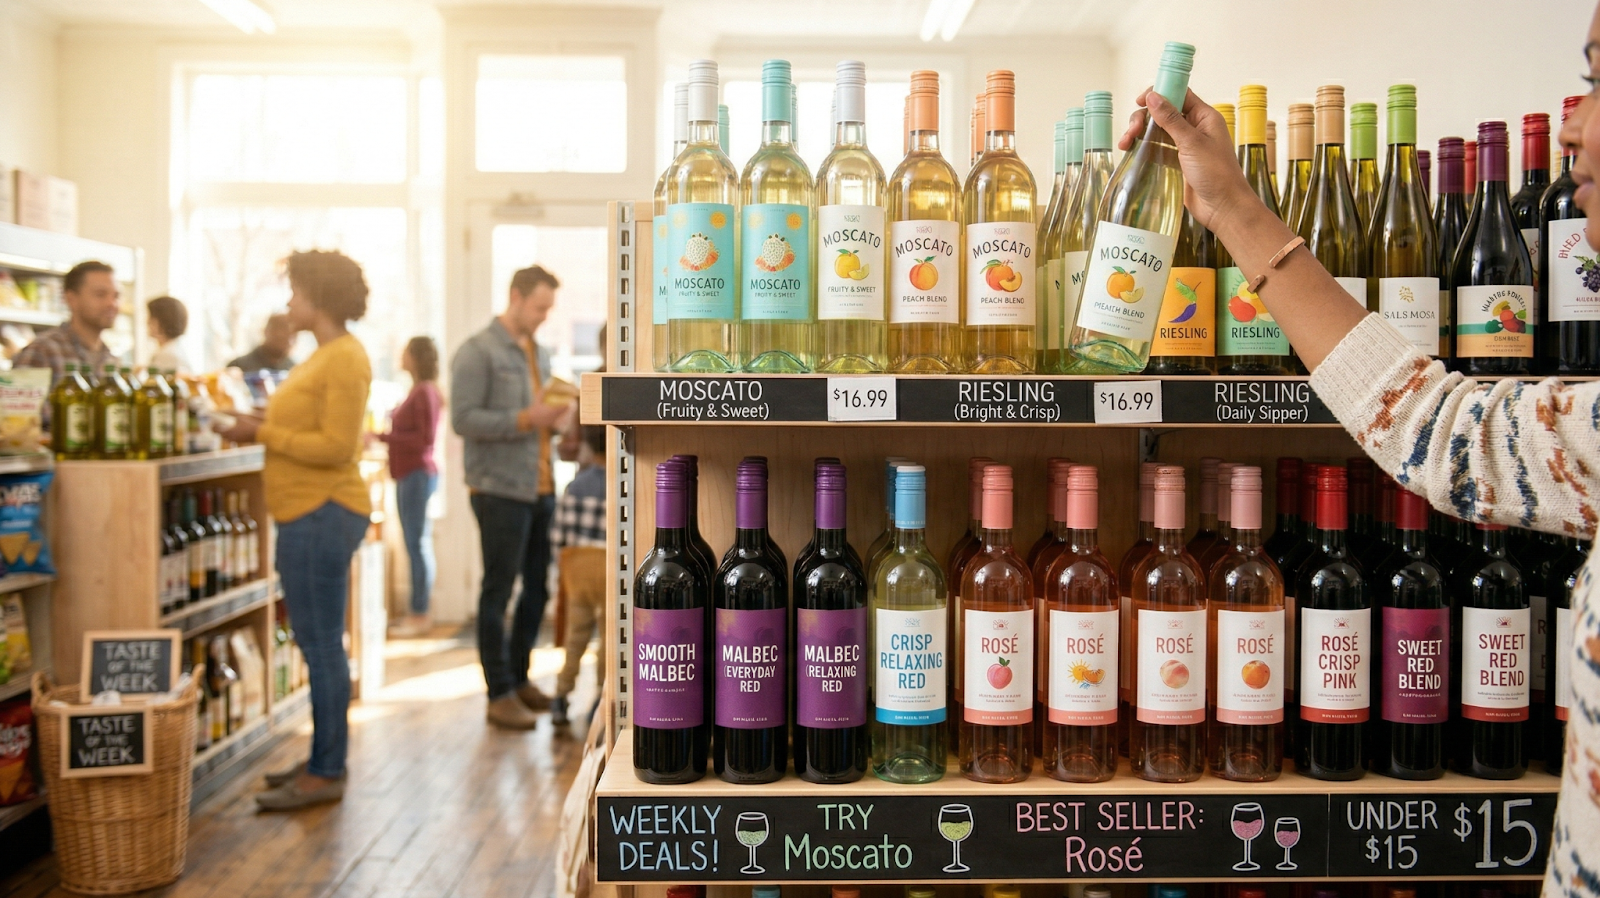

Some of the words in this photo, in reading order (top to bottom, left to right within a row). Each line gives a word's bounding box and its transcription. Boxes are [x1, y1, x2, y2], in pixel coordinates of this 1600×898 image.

[823, 229, 881, 249] MOSCATO
[895, 237, 953, 258] MOSCATO
[972, 239, 1031, 259] MOSCATO
[1100, 246, 1163, 273] MOSCATO
[674, 277, 725, 289] MOSCATO
[750, 278, 801, 290] MOSCATO
[902, 295, 925, 303] PEACH
[926, 295, 948, 303] BLEND
[1122, 307, 1145, 319] BLEND
[1160, 327, 1208, 339] RIESLING
[1231, 326, 1280, 339] RIESLING
[660, 380, 763, 401] MOSCATO
[833, 388, 888, 409] $16.99
[958, 381, 1055, 402] RIESLING
[1214, 382, 1310, 403] RIESLING
[1100, 391, 1153, 411] $16.99
[657, 402, 703, 421] (Fruity
[707, 403, 718, 418] &
[721, 402, 770, 421] Sweet)
[954, 403, 1003, 422] (Bright
[1006, 404, 1017, 419] &
[1019, 403, 1061, 422] Crisp)
[1216, 404, 1256, 423] (Daily
[1259, 404, 1309, 423] Sipper)
[103, 642, 161, 660] TASTE
[890, 633, 933, 651] CRISP
[981, 633, 1019, 655] ROSÉ
[1067, 633, 1104, 655] ROSÉ
[1156, 632, 1194, 654] ROSÉ
[1237, 633, 1274, 655] ROSÉ
[1321, 631, 1359, 652] ROSÉ
[1397, 639, 1443, 656] SWEET
[1478, 633, 1526, 650] SWEET
[638, 642, 696, 662] SMOOTH
[722, 644, 779, 663] MALBEC
[804, 644, 860, 663] MALBEC
[880, 651, 943, 671] RELAXING
[1489, 652, 1517, 669] RED
[107, 660, 127, 674] OF
[129, 659, 155, 673] THE
[723, 664, 776, 679] (EVERYDAY
[805, 664, 857, 679] (RELAXING
[1318, 653, 1361, 671] CRISP
[1407, 657, 1434, 673] RED
[639, 663, 695, 682] MALBEC
[898, 672, 926, 689] RED
[1323, 672, 1357, 689] PINK
[1398, 673, 1442, 690] BLEND
[1480, 669, 1525, 687] BLEND
[100, 673, 159, 692] WEEK
[740, 680, 761, 692] RED
[822, 680, 843, 692] RED
[78, 716, 136, 735] TASTE
[85, 735, 101, 748] OF
[106, 734, 129, 747] THE
[78, 744, 136, 766] WEEK
[609, 805, 722, 835] WEEKLY
[816, 803, 875, 831] TRY
[1016, 801, 1086, 833] BEST
[1096, 800, 1205, 832] SELLER:
[1347, 800, 1439, 831] UNDER
[1453, 798, 1538, 869] $15
[619, 839, 719, 873] DEALS!
[784, 832, 914, 872] Moscato
[1065, 836, 1144, 873] Rosé
[1365, 834, 1419, 870] $15
